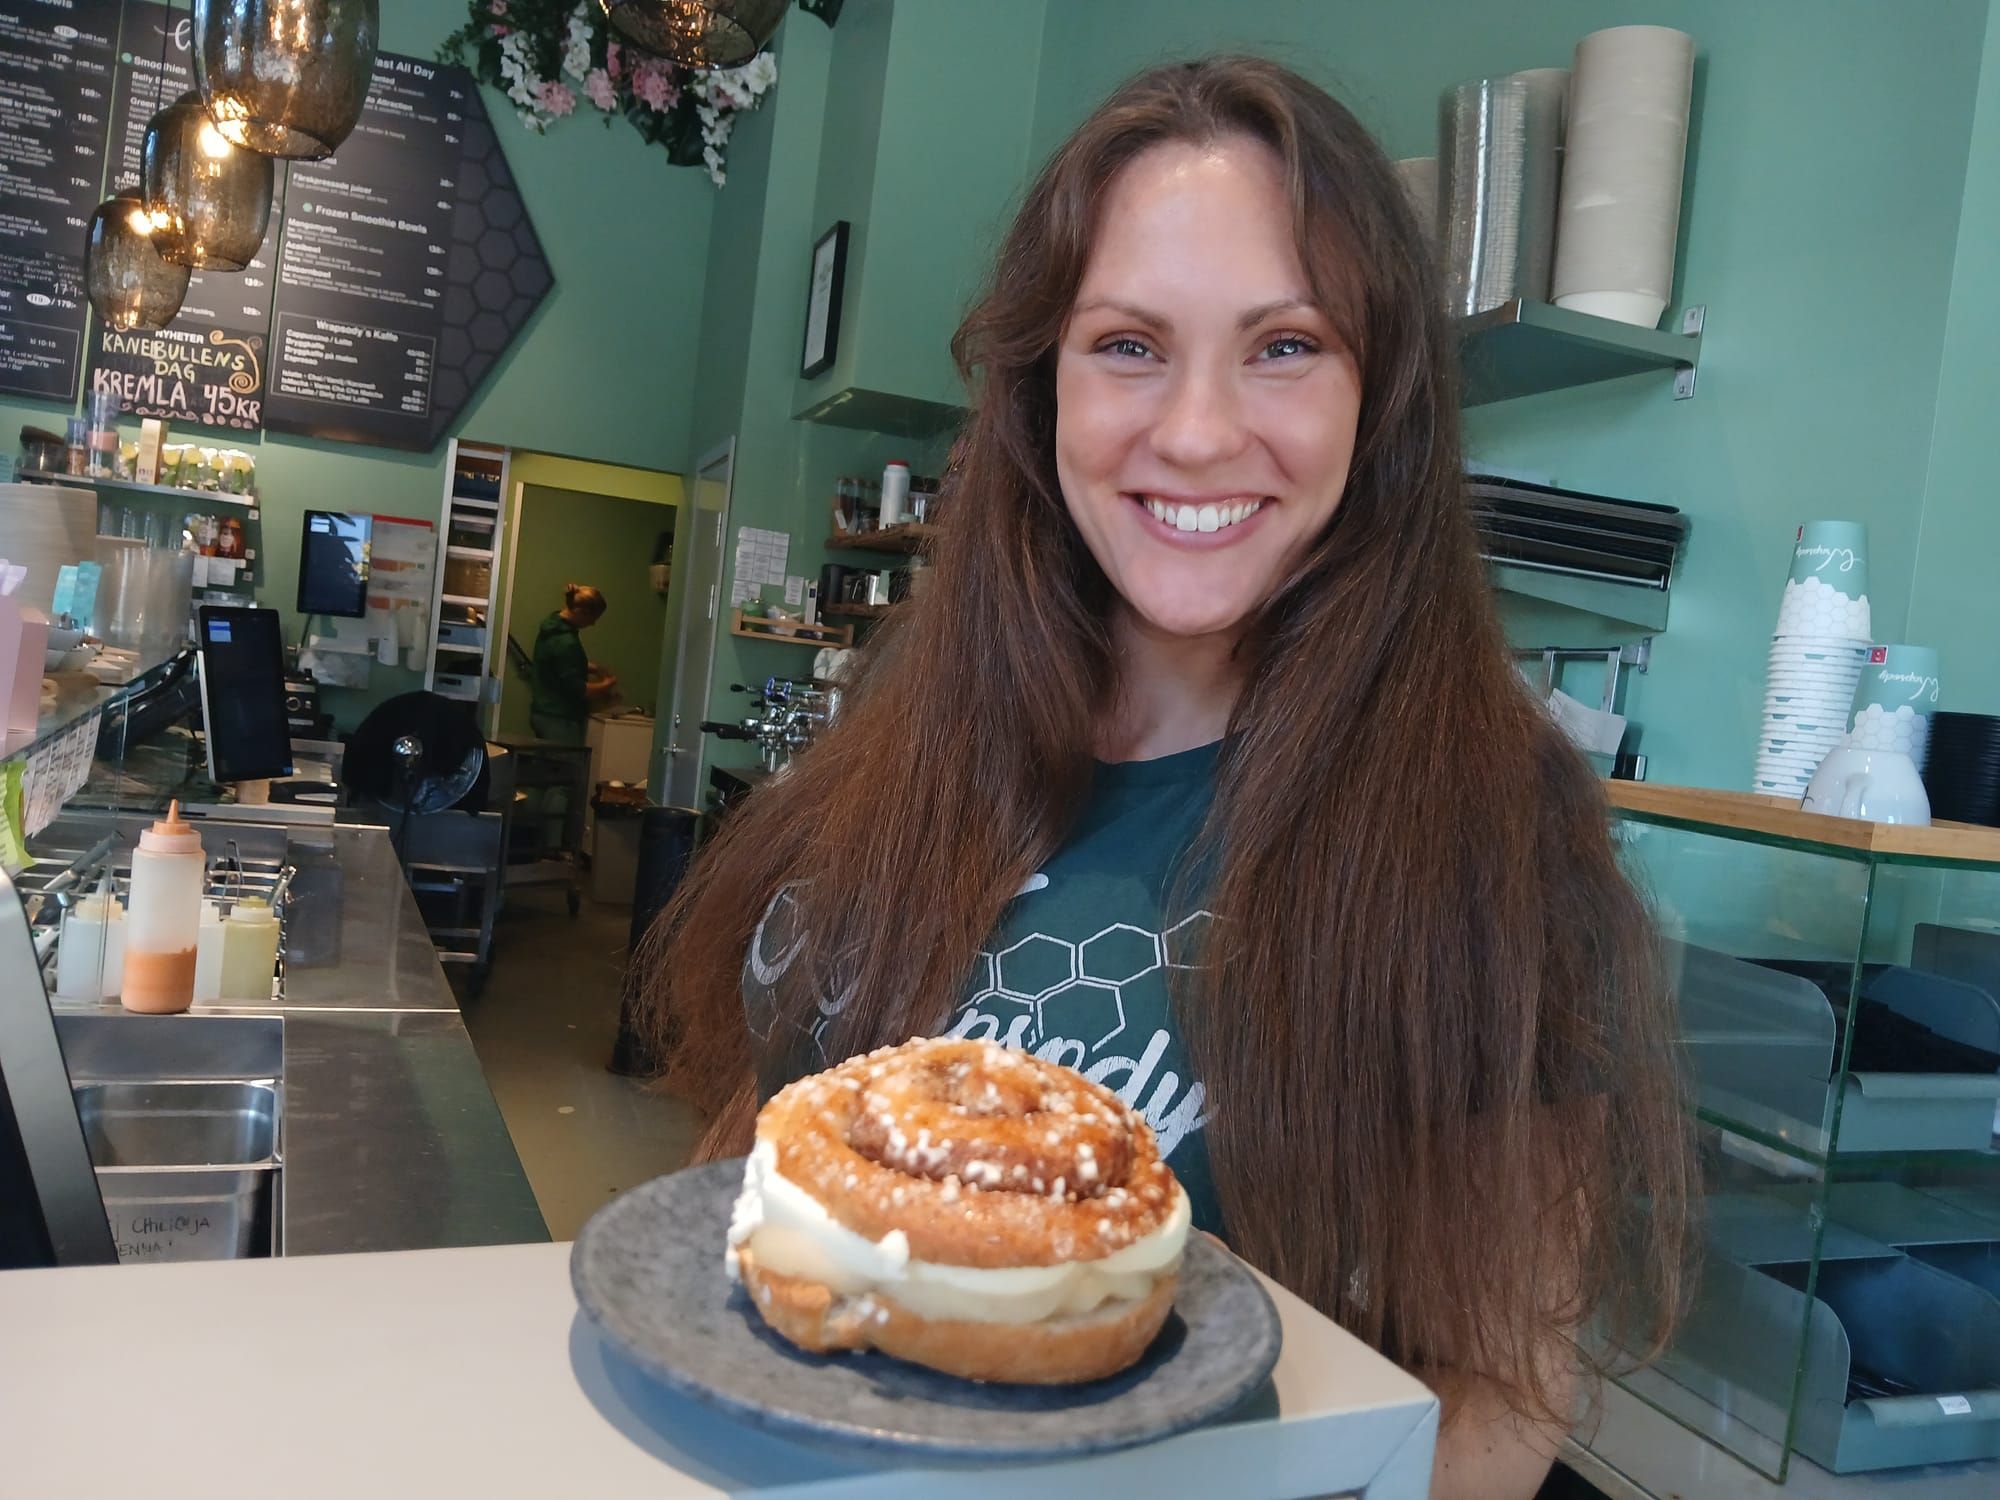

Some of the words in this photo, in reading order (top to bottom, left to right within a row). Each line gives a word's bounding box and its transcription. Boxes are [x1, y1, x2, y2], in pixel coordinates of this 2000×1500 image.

[134, 55, 187, 75] Smoothies
[396, 61, 412, 74] All
[413, 64, 435, 81] Day
[315, 204, 349, 220] Frozen
[351, 211, 397, 229] Smoothie
[155, 329, 204, 344] NYHETER
[154, 359, 196, 384] DAG
[94, 368, 187, 411] KREMLA
